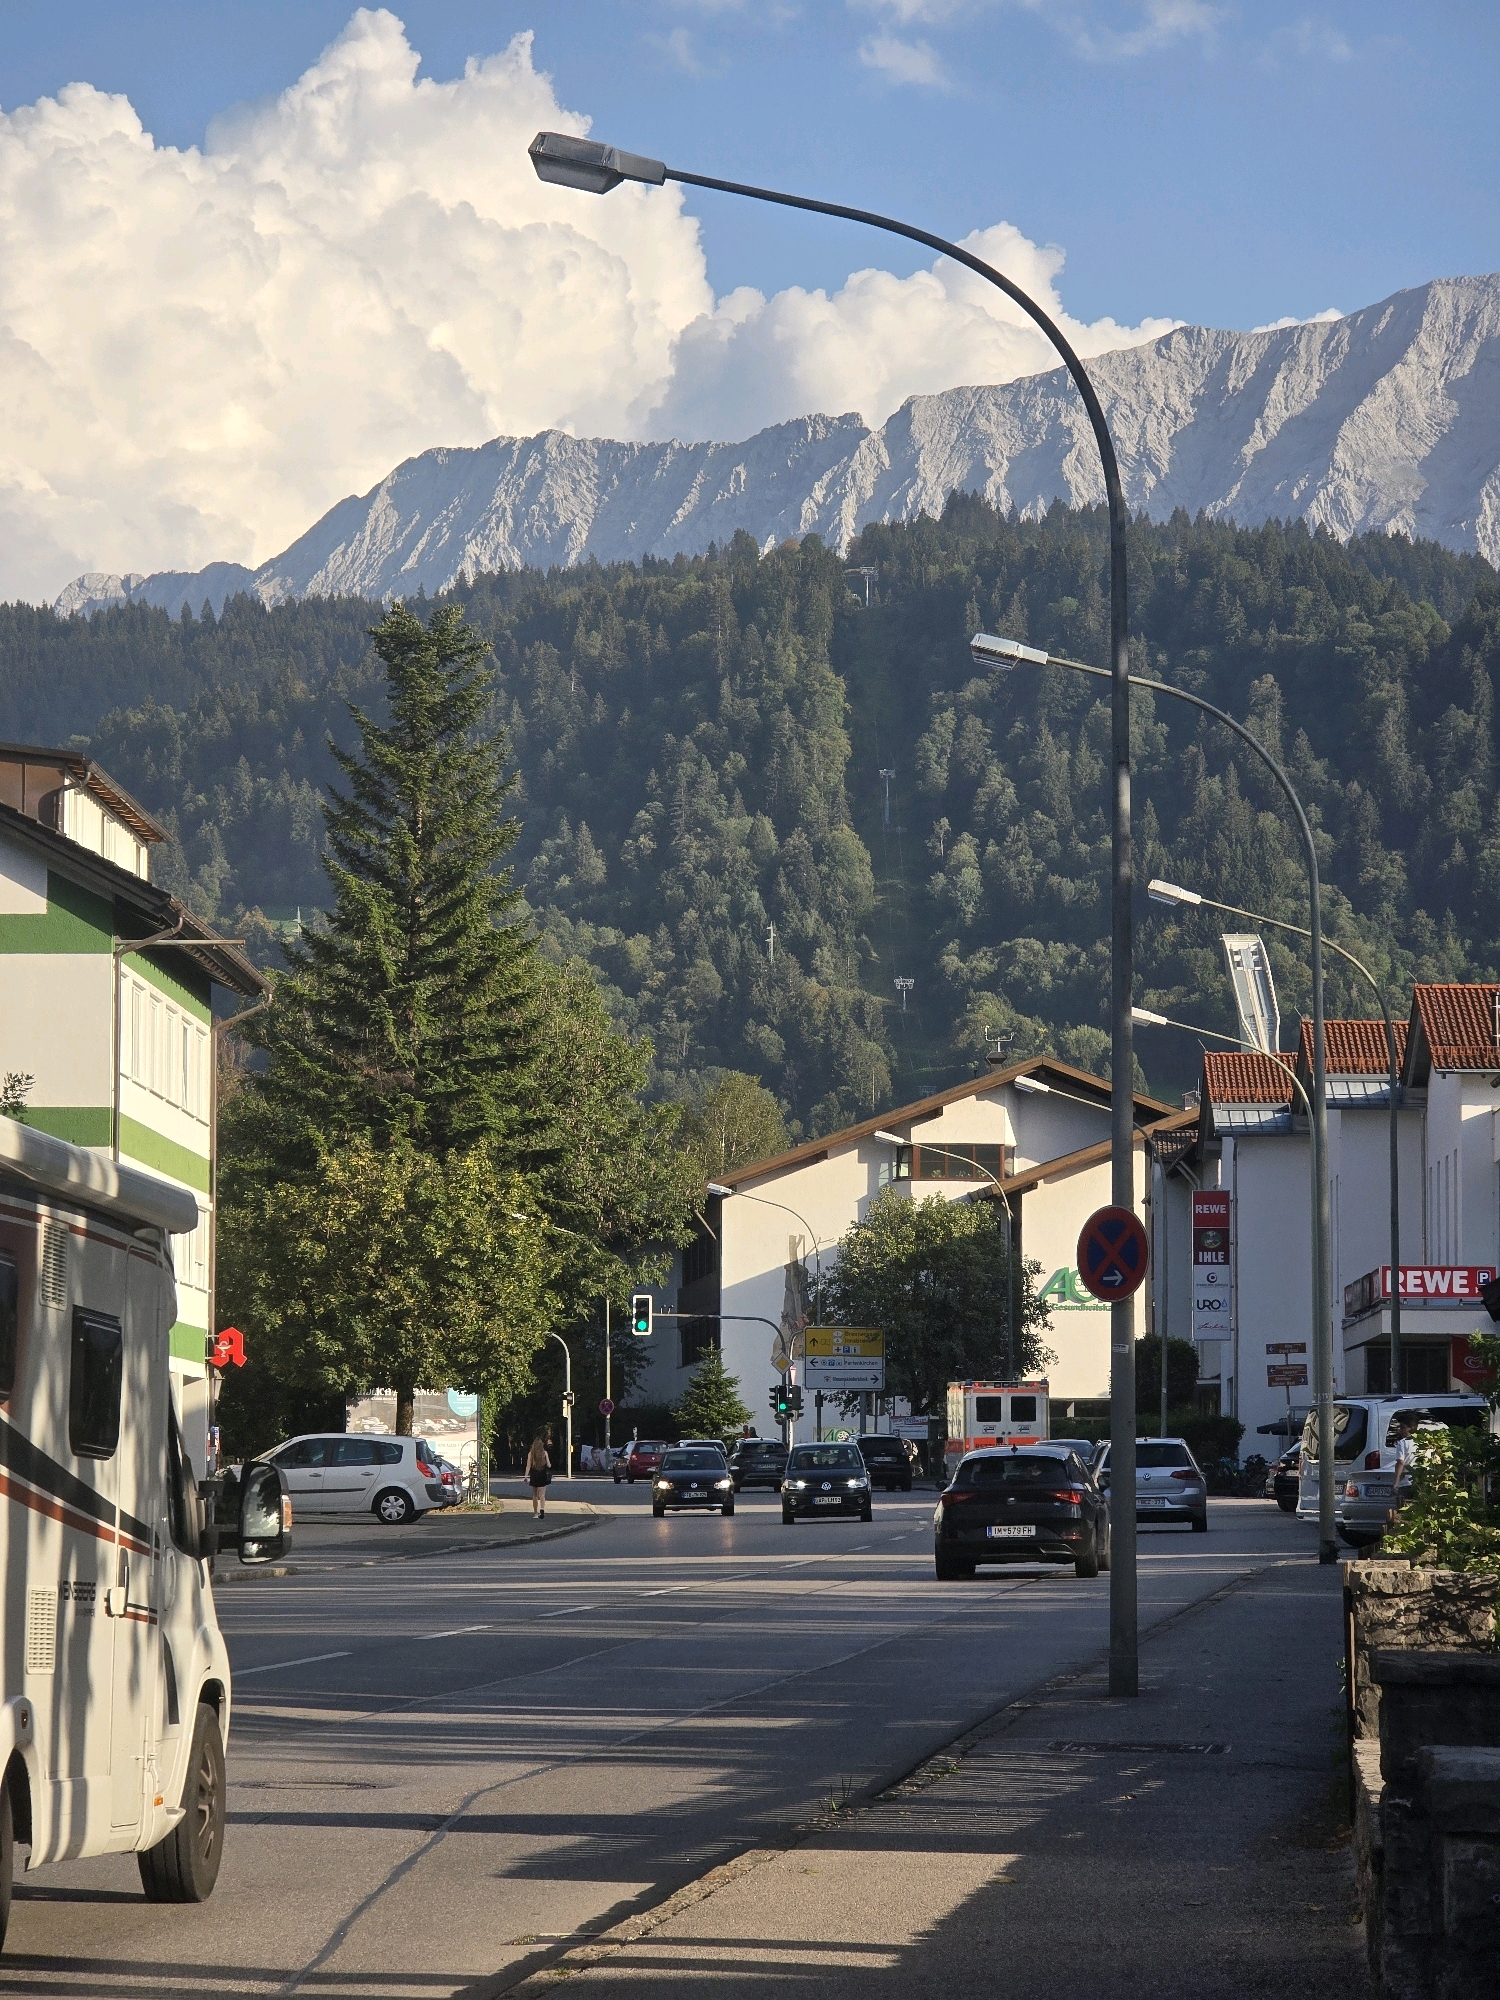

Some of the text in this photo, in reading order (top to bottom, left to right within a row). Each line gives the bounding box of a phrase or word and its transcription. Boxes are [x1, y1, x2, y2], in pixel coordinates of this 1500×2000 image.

[1195, 1204, 1227, 1214] REWE
[1198, 1251, 1225, 1263] IHLE
[1386, 1270, 1470, 1294] REWE
[1196, 1298, 1221, 1311] URO
